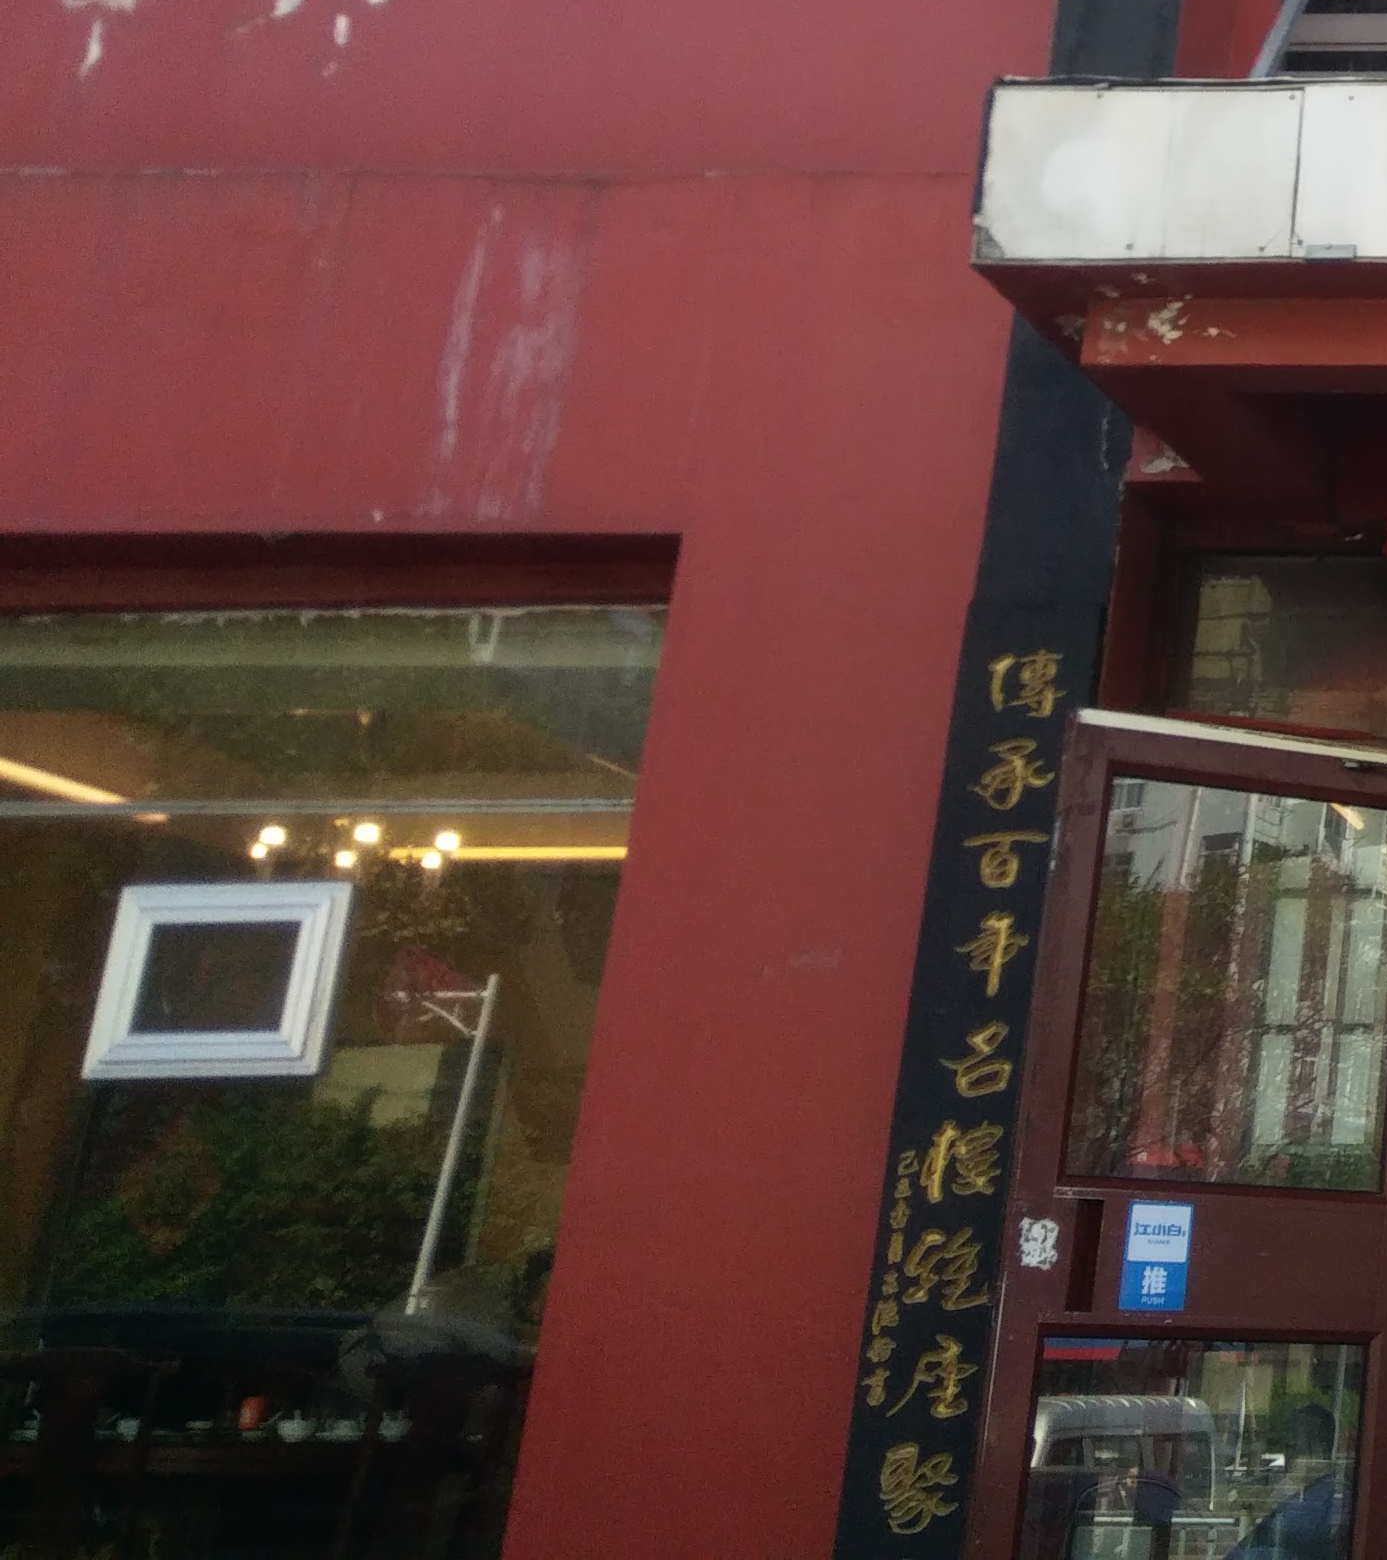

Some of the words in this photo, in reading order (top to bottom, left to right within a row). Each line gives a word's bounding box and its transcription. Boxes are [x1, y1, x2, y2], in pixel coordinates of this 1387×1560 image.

[1133, 1222, 1183, 1237] 江小白
[1141, 1265, 1169, 1295] 推
[1141, 1295, 1165, 1305] PUSH
